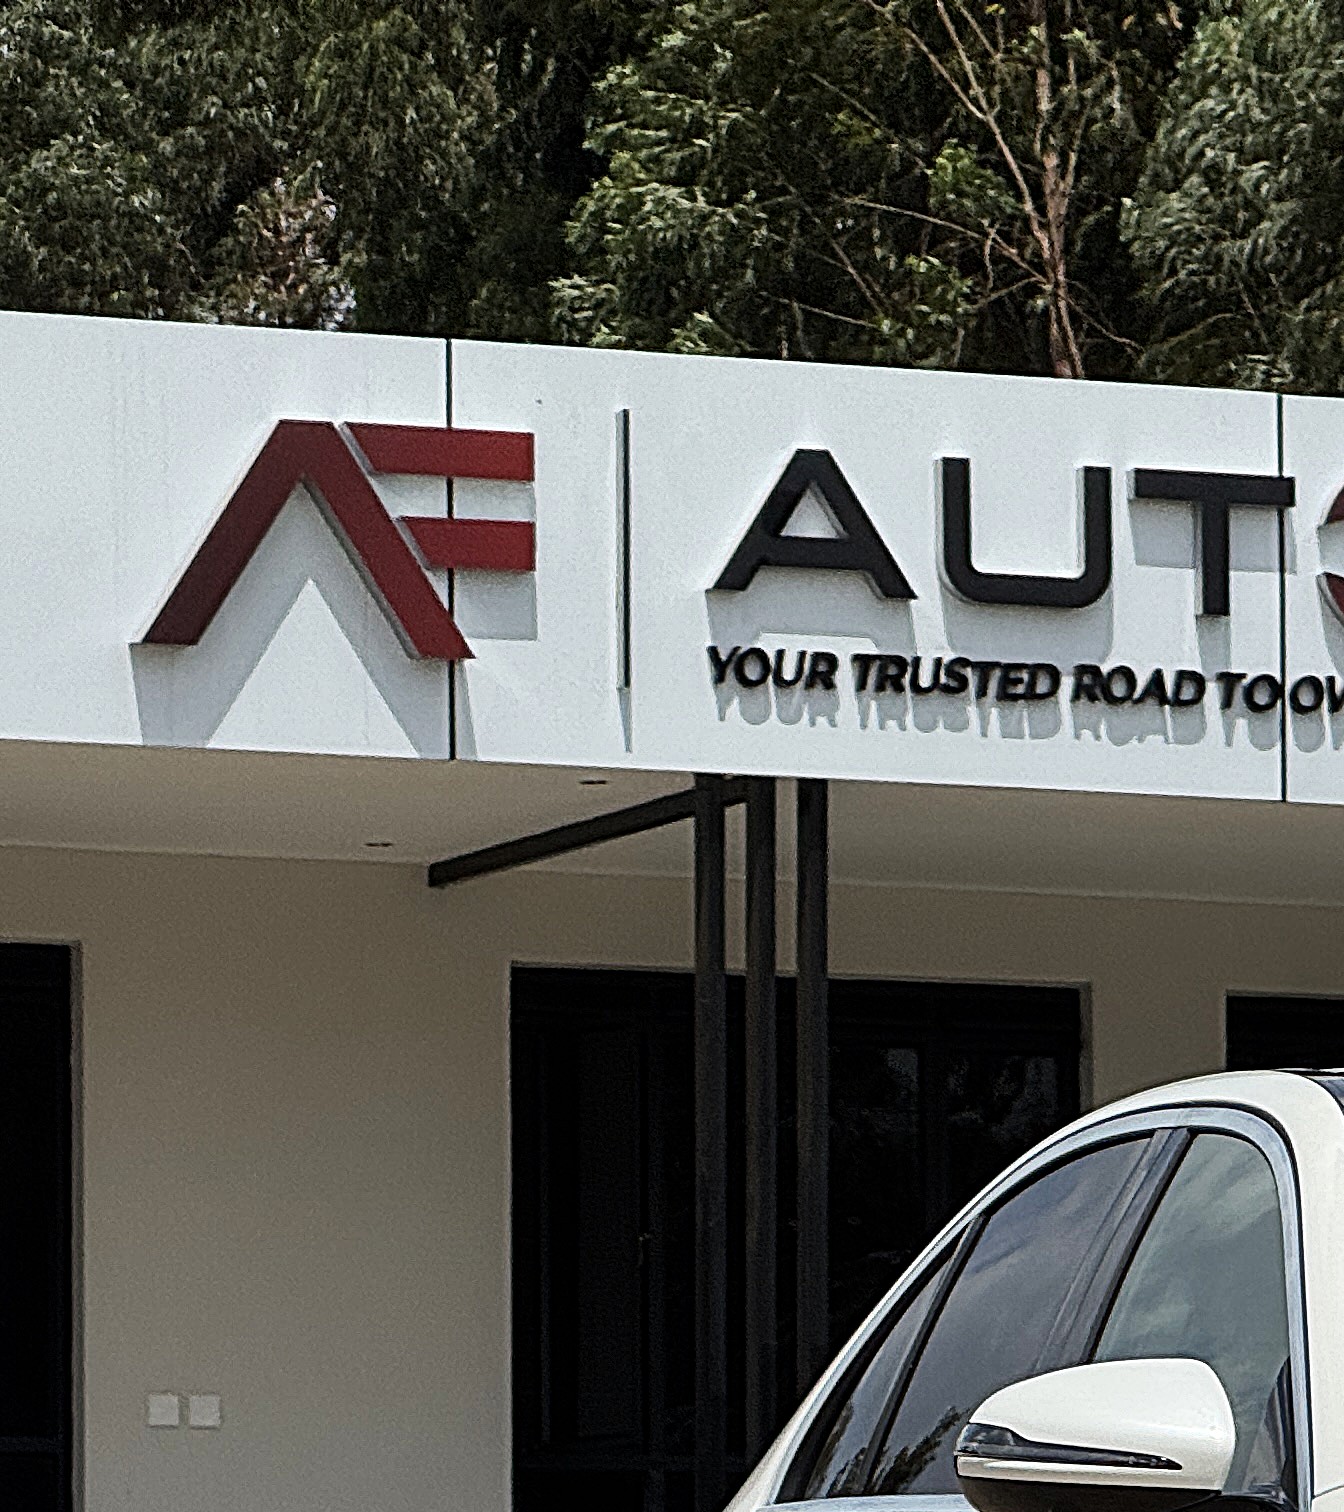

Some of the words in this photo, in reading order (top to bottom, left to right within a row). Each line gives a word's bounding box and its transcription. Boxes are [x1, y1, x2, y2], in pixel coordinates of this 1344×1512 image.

[707, 645, 838, 691] YOUR
[852, 652, 1060, 701] TRUSTED
[1073, 664, 1206, 706] ROAD
[1216, 672, 1282, 713] TO
